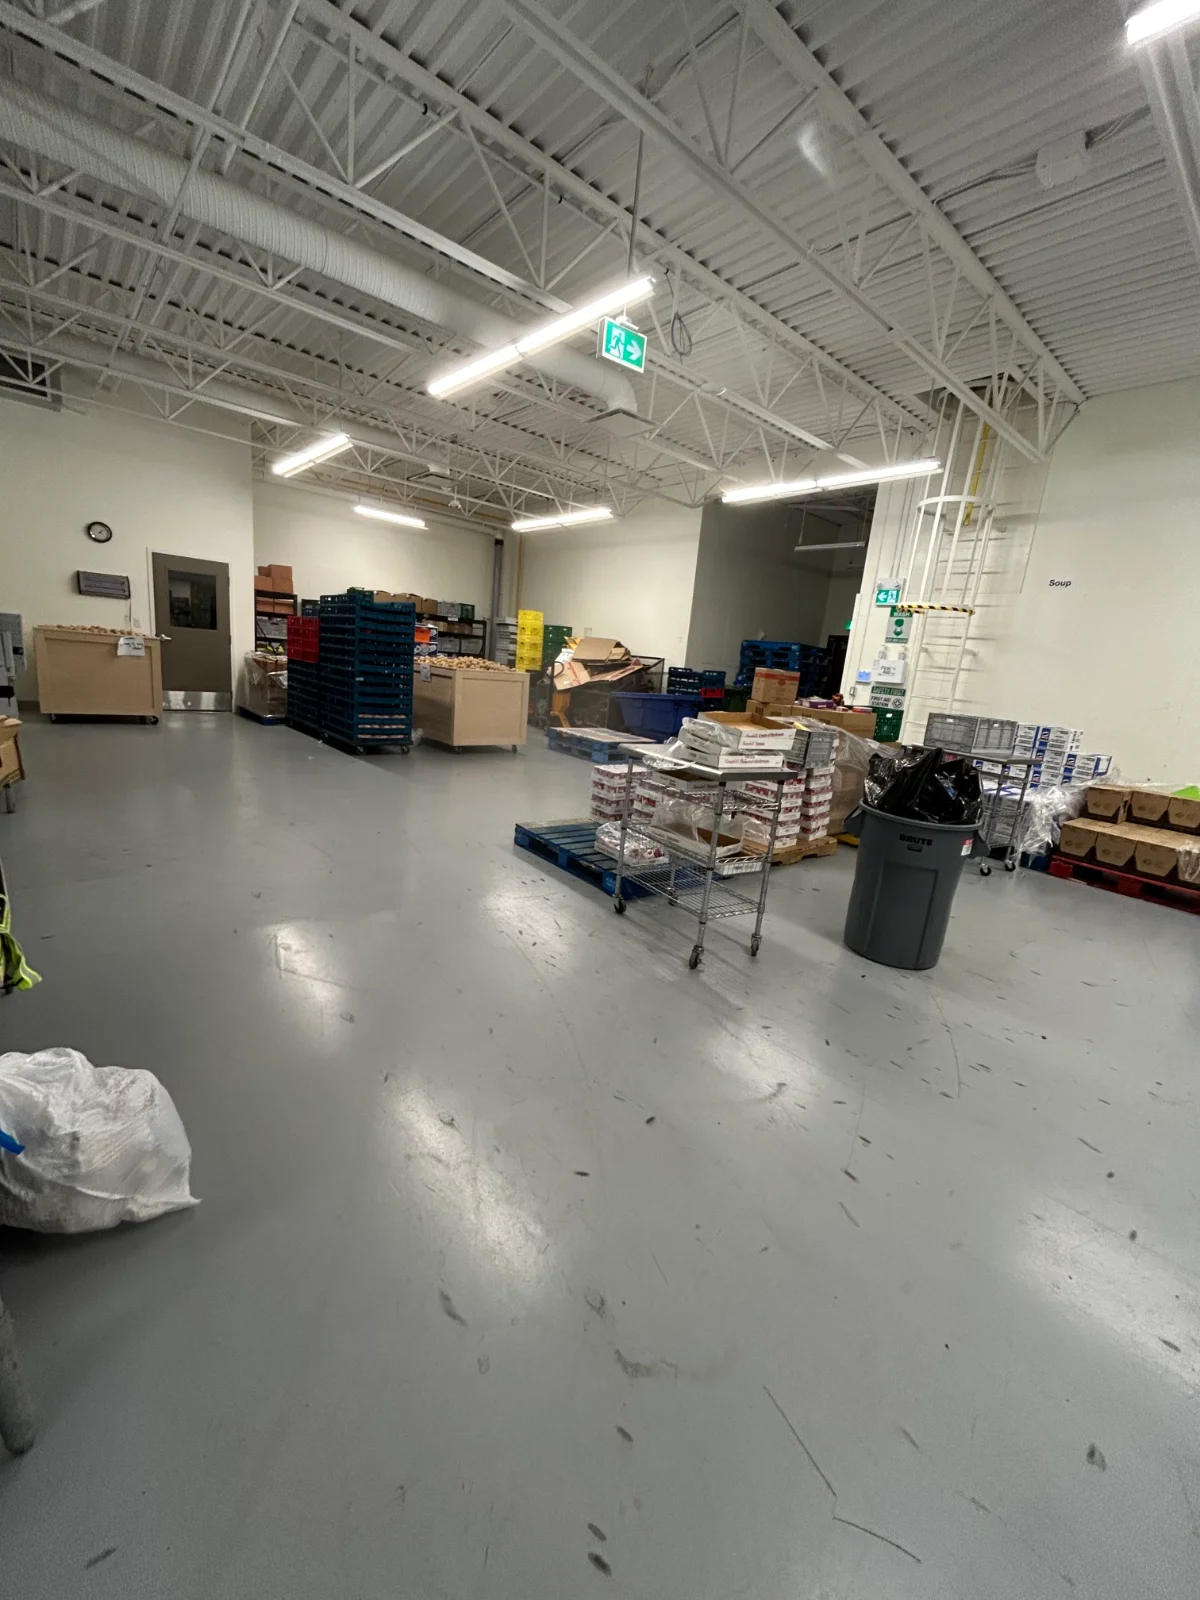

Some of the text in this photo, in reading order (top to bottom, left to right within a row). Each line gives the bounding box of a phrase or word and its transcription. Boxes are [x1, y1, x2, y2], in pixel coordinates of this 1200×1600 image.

[1048, 579, 1072, 588] Soup
[873, 686, 904, 696] SAFETY FIRST
[899, 833, 933, 846] BRUTE
